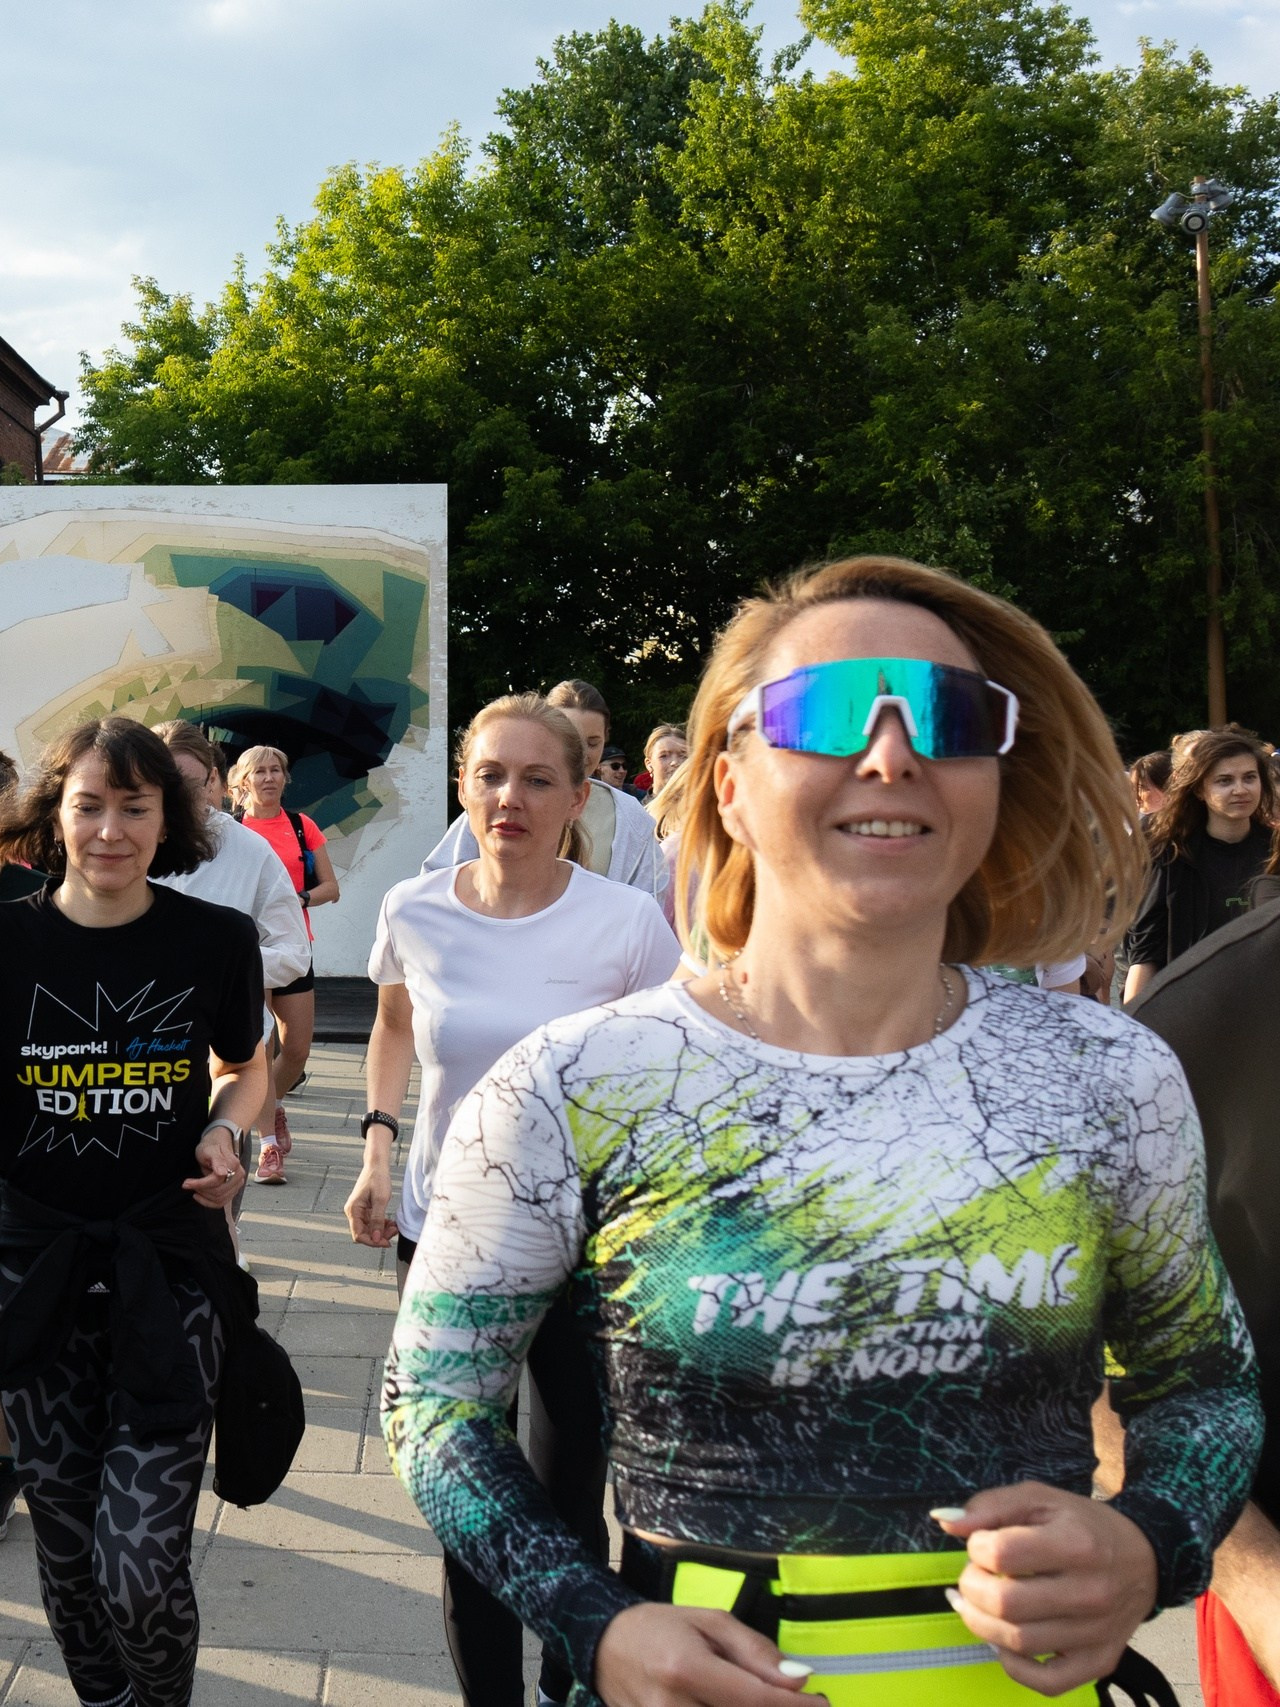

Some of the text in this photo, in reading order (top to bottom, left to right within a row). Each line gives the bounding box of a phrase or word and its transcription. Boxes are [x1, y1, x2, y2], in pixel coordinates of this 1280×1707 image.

[20, 1041, 108, 1060] skypark!
[16, 1059, 191, 1088] JUMPERS
[687, 1242, 1081, 1335] THE TIME
[771, 1343, 984, 1387] IS NOW
